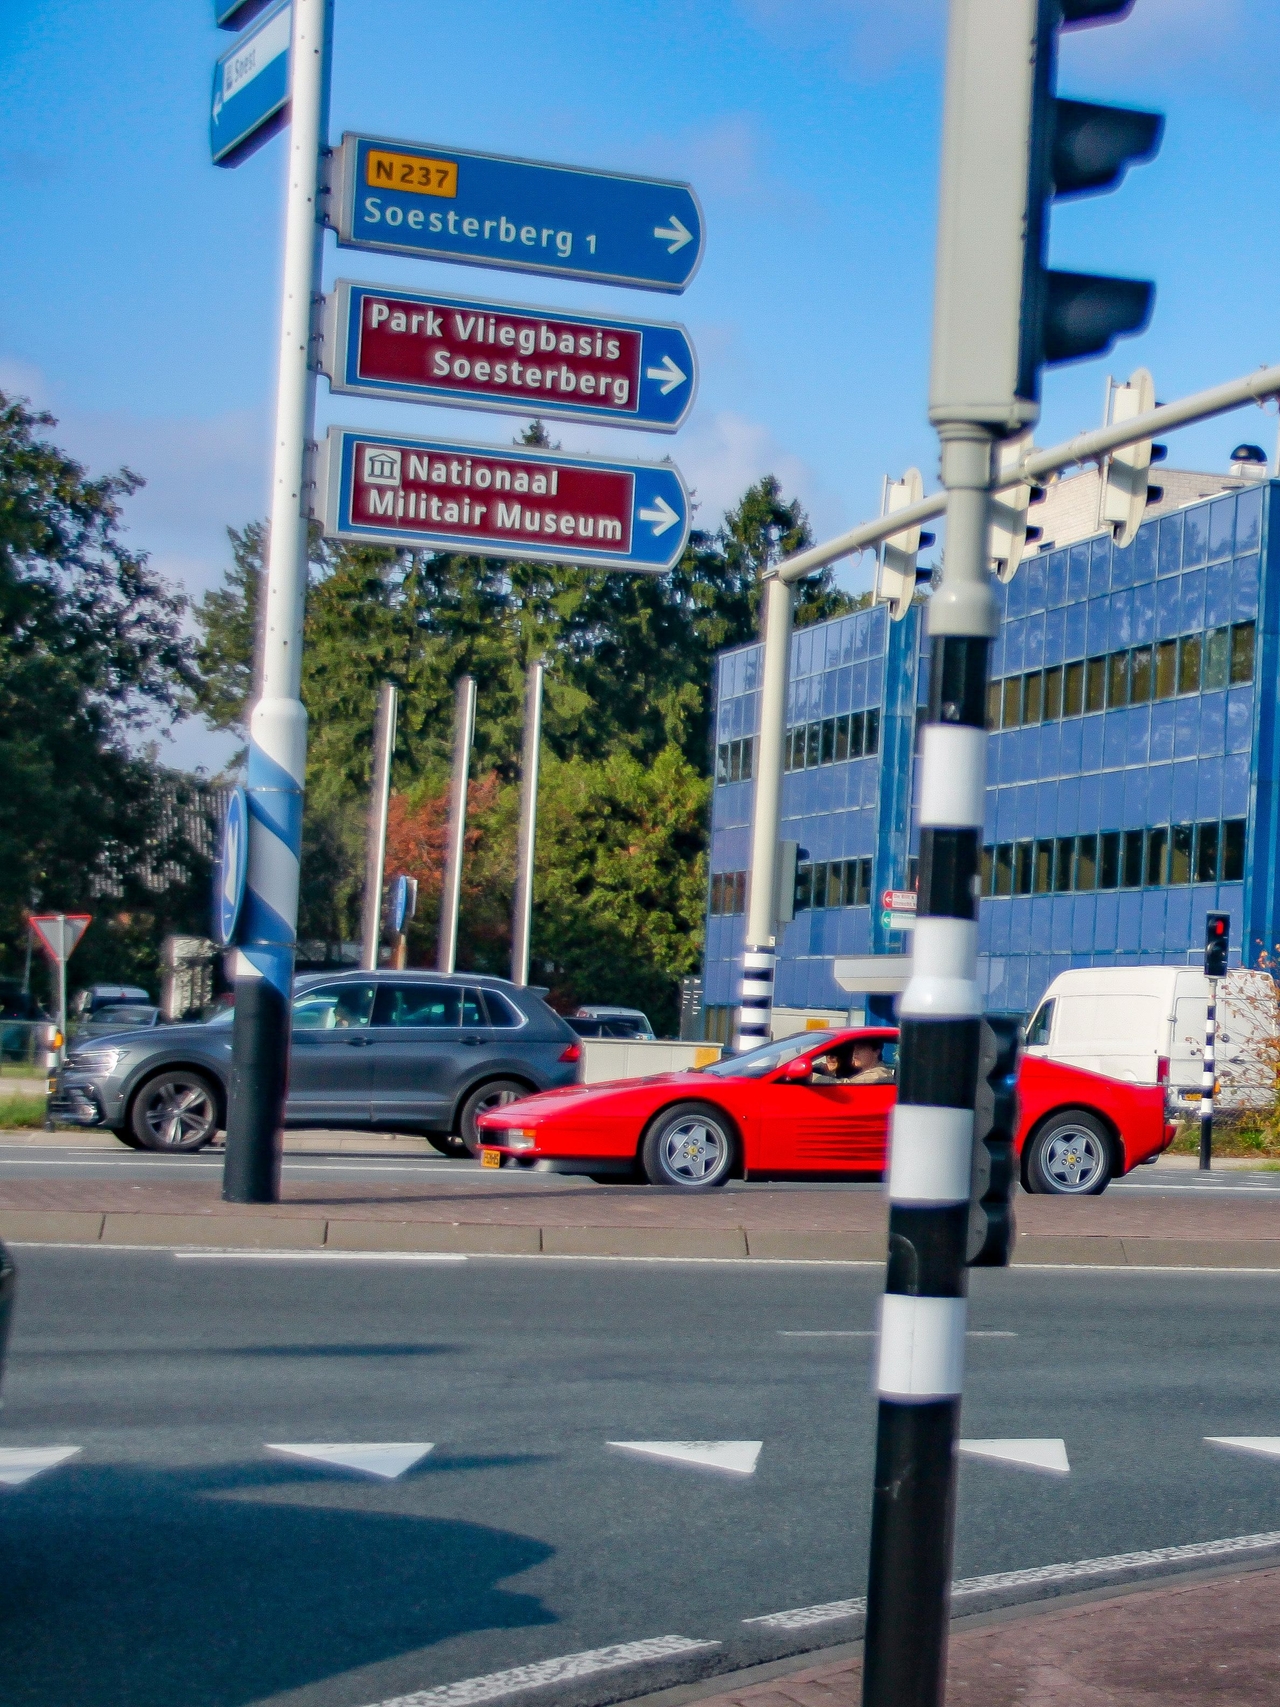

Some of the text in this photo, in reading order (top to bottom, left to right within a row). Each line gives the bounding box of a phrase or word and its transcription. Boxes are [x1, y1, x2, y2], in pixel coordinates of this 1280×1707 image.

[364, 197, 597, 258] Soesterberg 1
[371, 303, 621, 361] Park Vliegbasis
[433, 351, 630, 405] Soesterberg
[409, 455, 559, 496] Nationaal
[369, 489, 622, 540] Militair Museum
